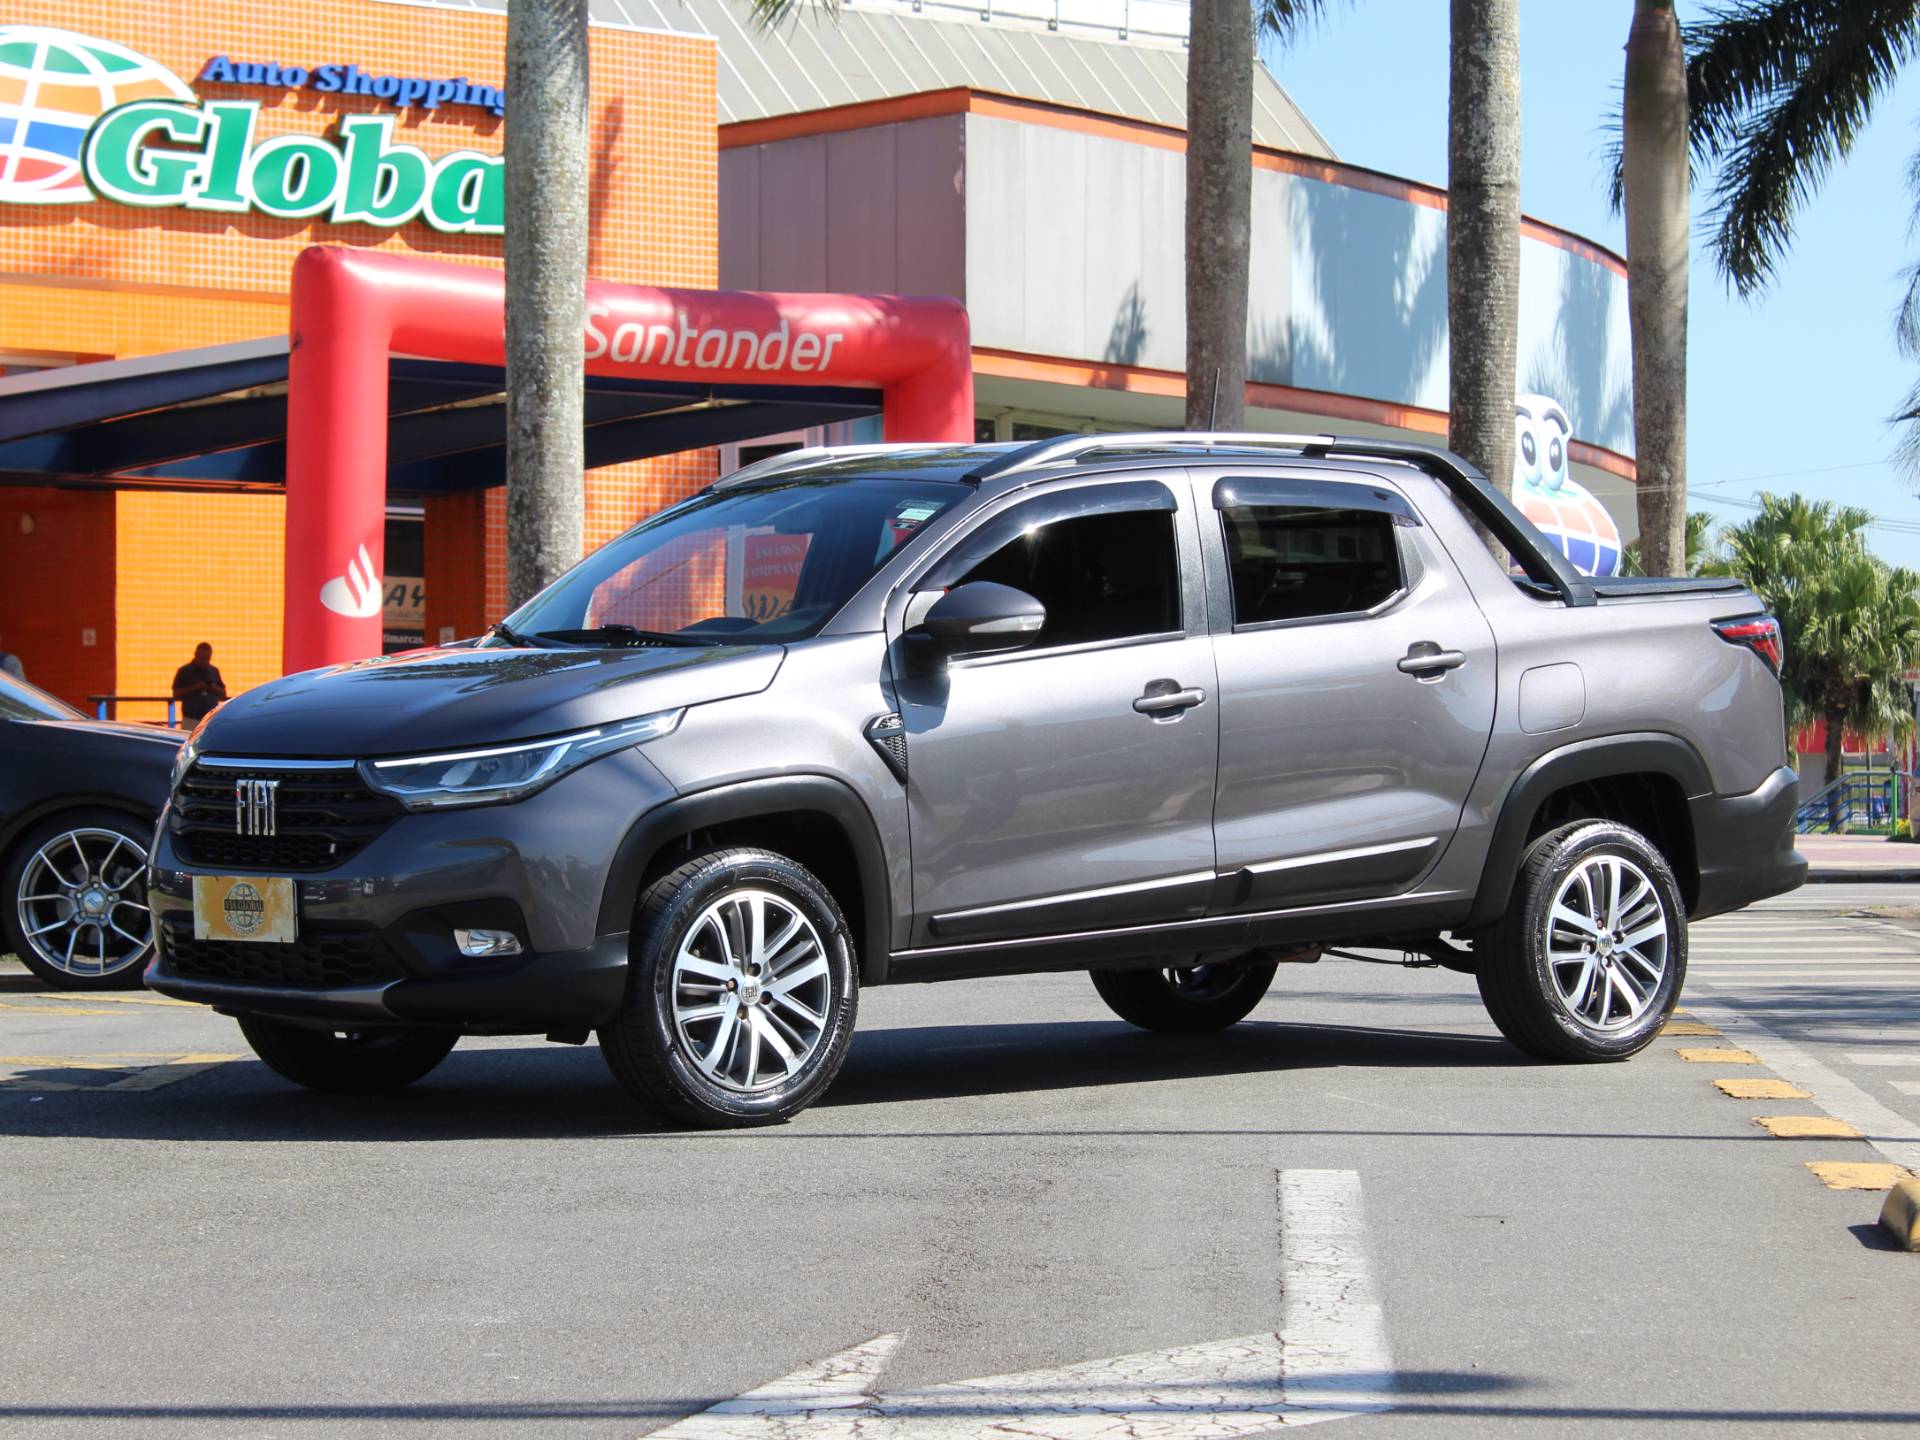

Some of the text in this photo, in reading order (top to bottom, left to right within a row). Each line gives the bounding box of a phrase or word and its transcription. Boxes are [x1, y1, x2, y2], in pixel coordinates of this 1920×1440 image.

[202, 55, 308, 87] Auto
[84, 100, 505, 233] Globa
[584, 308, 843, 371] Santander
[236, 779, 280, 836] FIAT
